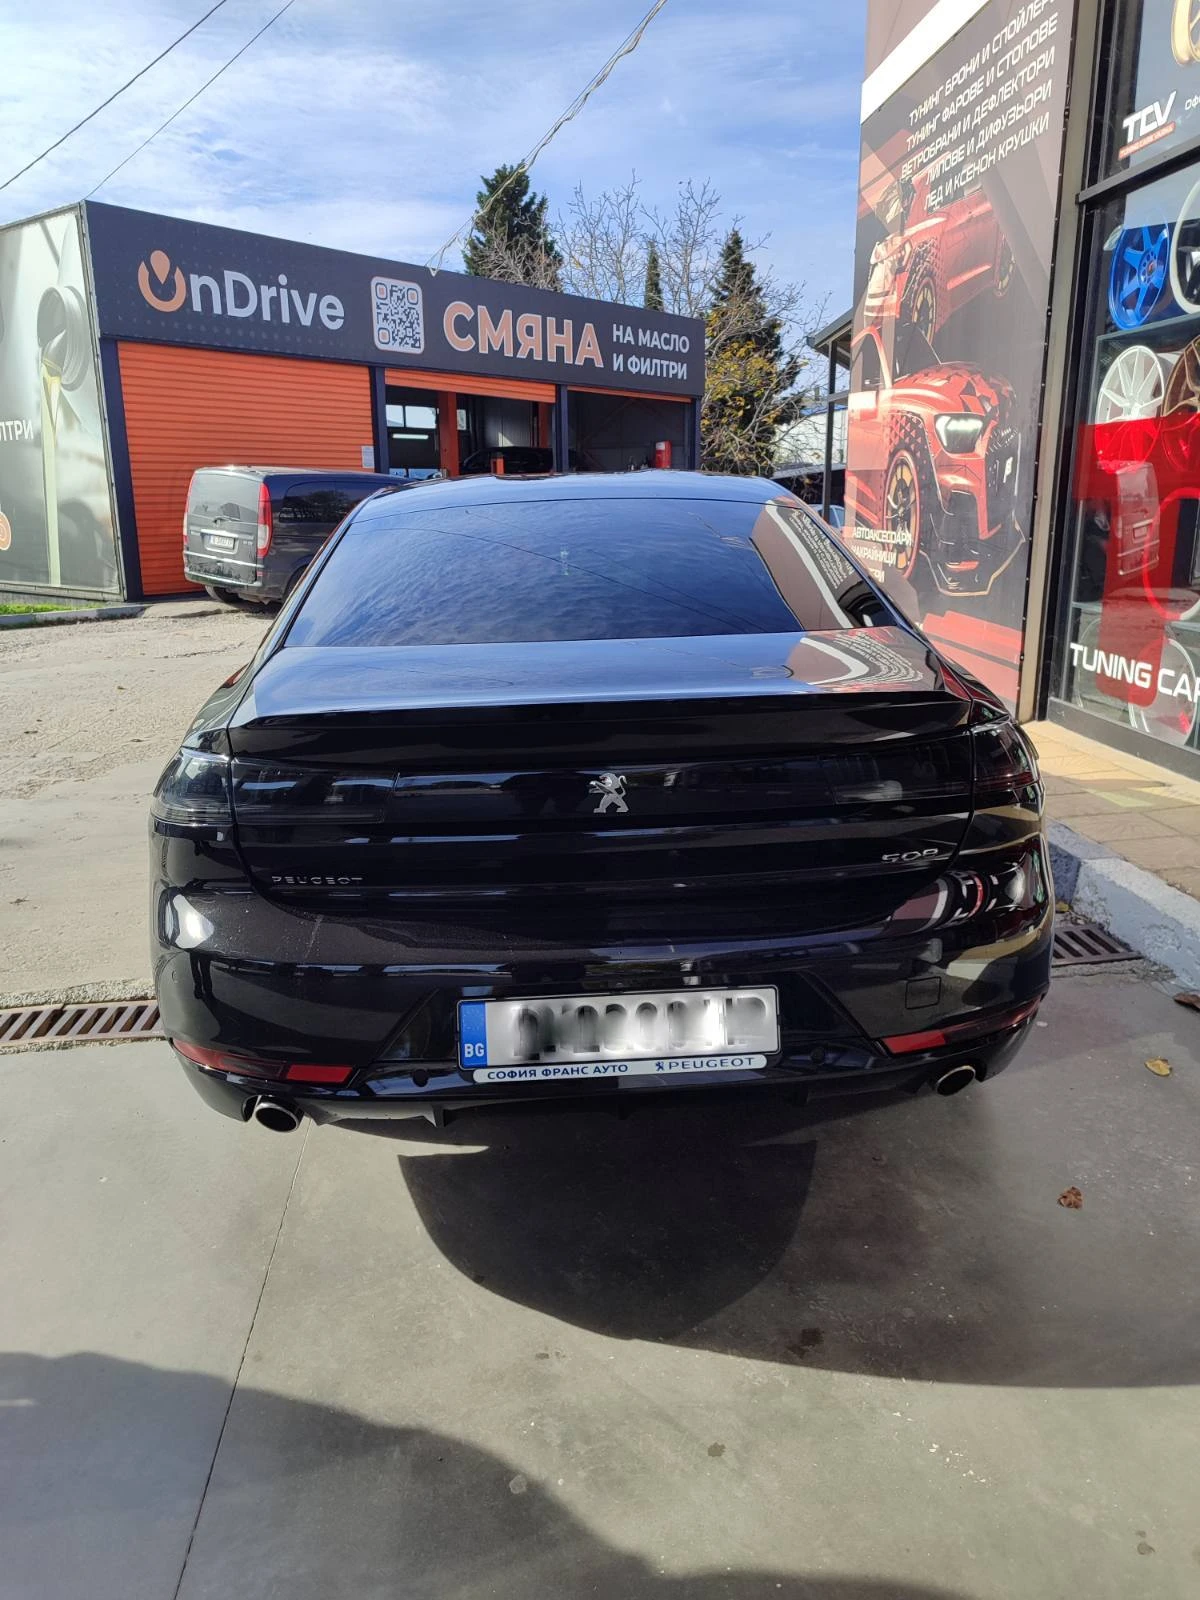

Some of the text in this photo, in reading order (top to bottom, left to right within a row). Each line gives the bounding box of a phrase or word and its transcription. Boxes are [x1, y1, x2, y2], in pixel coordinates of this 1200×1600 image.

[901, 46, 1055, 178] ВЕТРОБРАНИ И ДЕФЛЕКТОРИ
[906, 12, 1058, 151] ТУНИНГ ФАРОВЕ И СТОПОВЕ
[909, 86, 943, 126] ТУНИНГ
[945, 52, 980, 97] БРОНИ
[982, 43, 990, 64] И
[924, 112, 1049, 210] ЛЕД И КСЕНОН КРУШКИ
[926, 79, 1052, 185] ЛИПОВЕ И ДИФУЗЬОРИ
[443, 301, 690, 368] СМЯНА НА МАСЛО
[612, 353, 688, 380] И ФИЛТРИ
[1070, 642, 1152, 689] TUNING
[464, 1043, 485, 1058] BG
[487, 1064, 628, 1080] СОФИЯ ФРАНС АУТО
[668, 1057, 754, 1071] PEUGEOT
